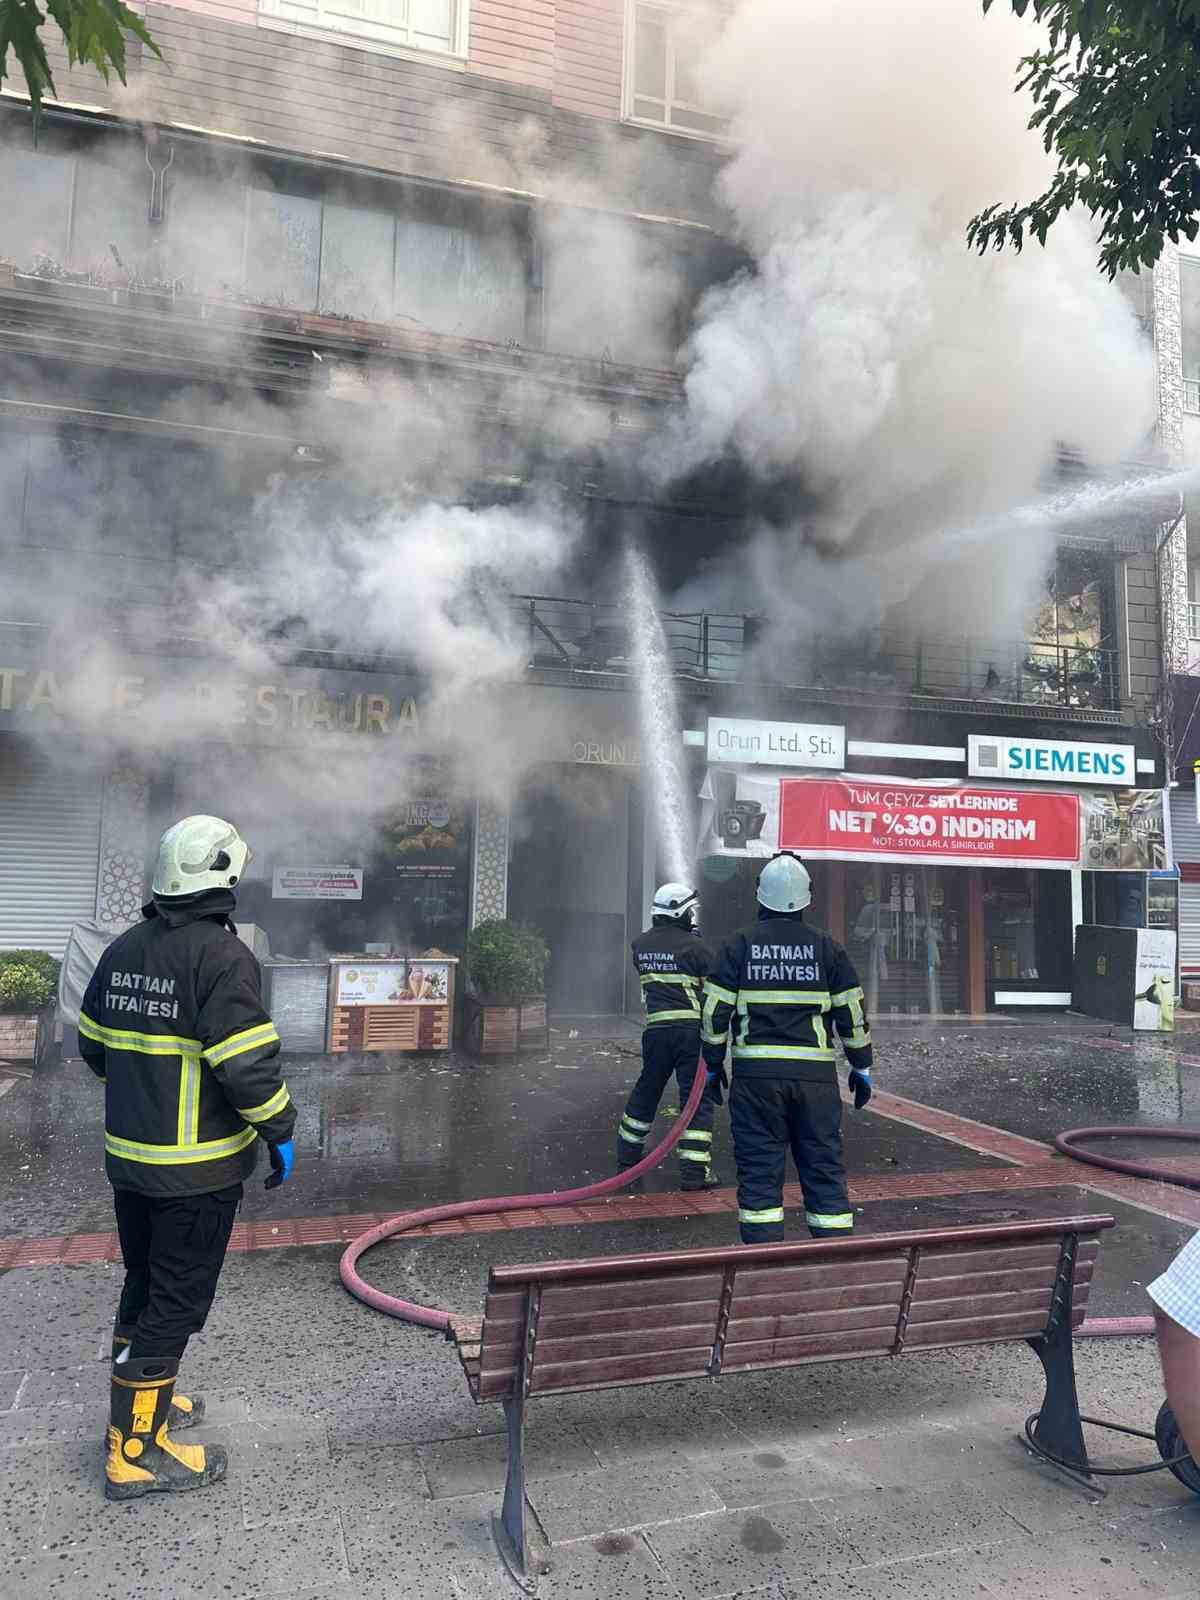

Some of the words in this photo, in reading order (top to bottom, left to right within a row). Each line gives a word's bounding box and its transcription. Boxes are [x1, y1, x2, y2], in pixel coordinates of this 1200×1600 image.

[718, 729, 760, 750] Orun
[768, 732, 802, 752] Ltd.
[808, 735, 836, 757] Şti.
[1008, 747, 1126, 776] SIEMENS
[829, 809, 877, 833] NET
[882, 812, 937, 836] %30
[897, 838, 949, 849] STOKLARLA
[751, 944, 814, 960] BATMAN
[111, 971, 176, 995] BATMAN
[747, 961, 820, 981] İTFAİYESİ
